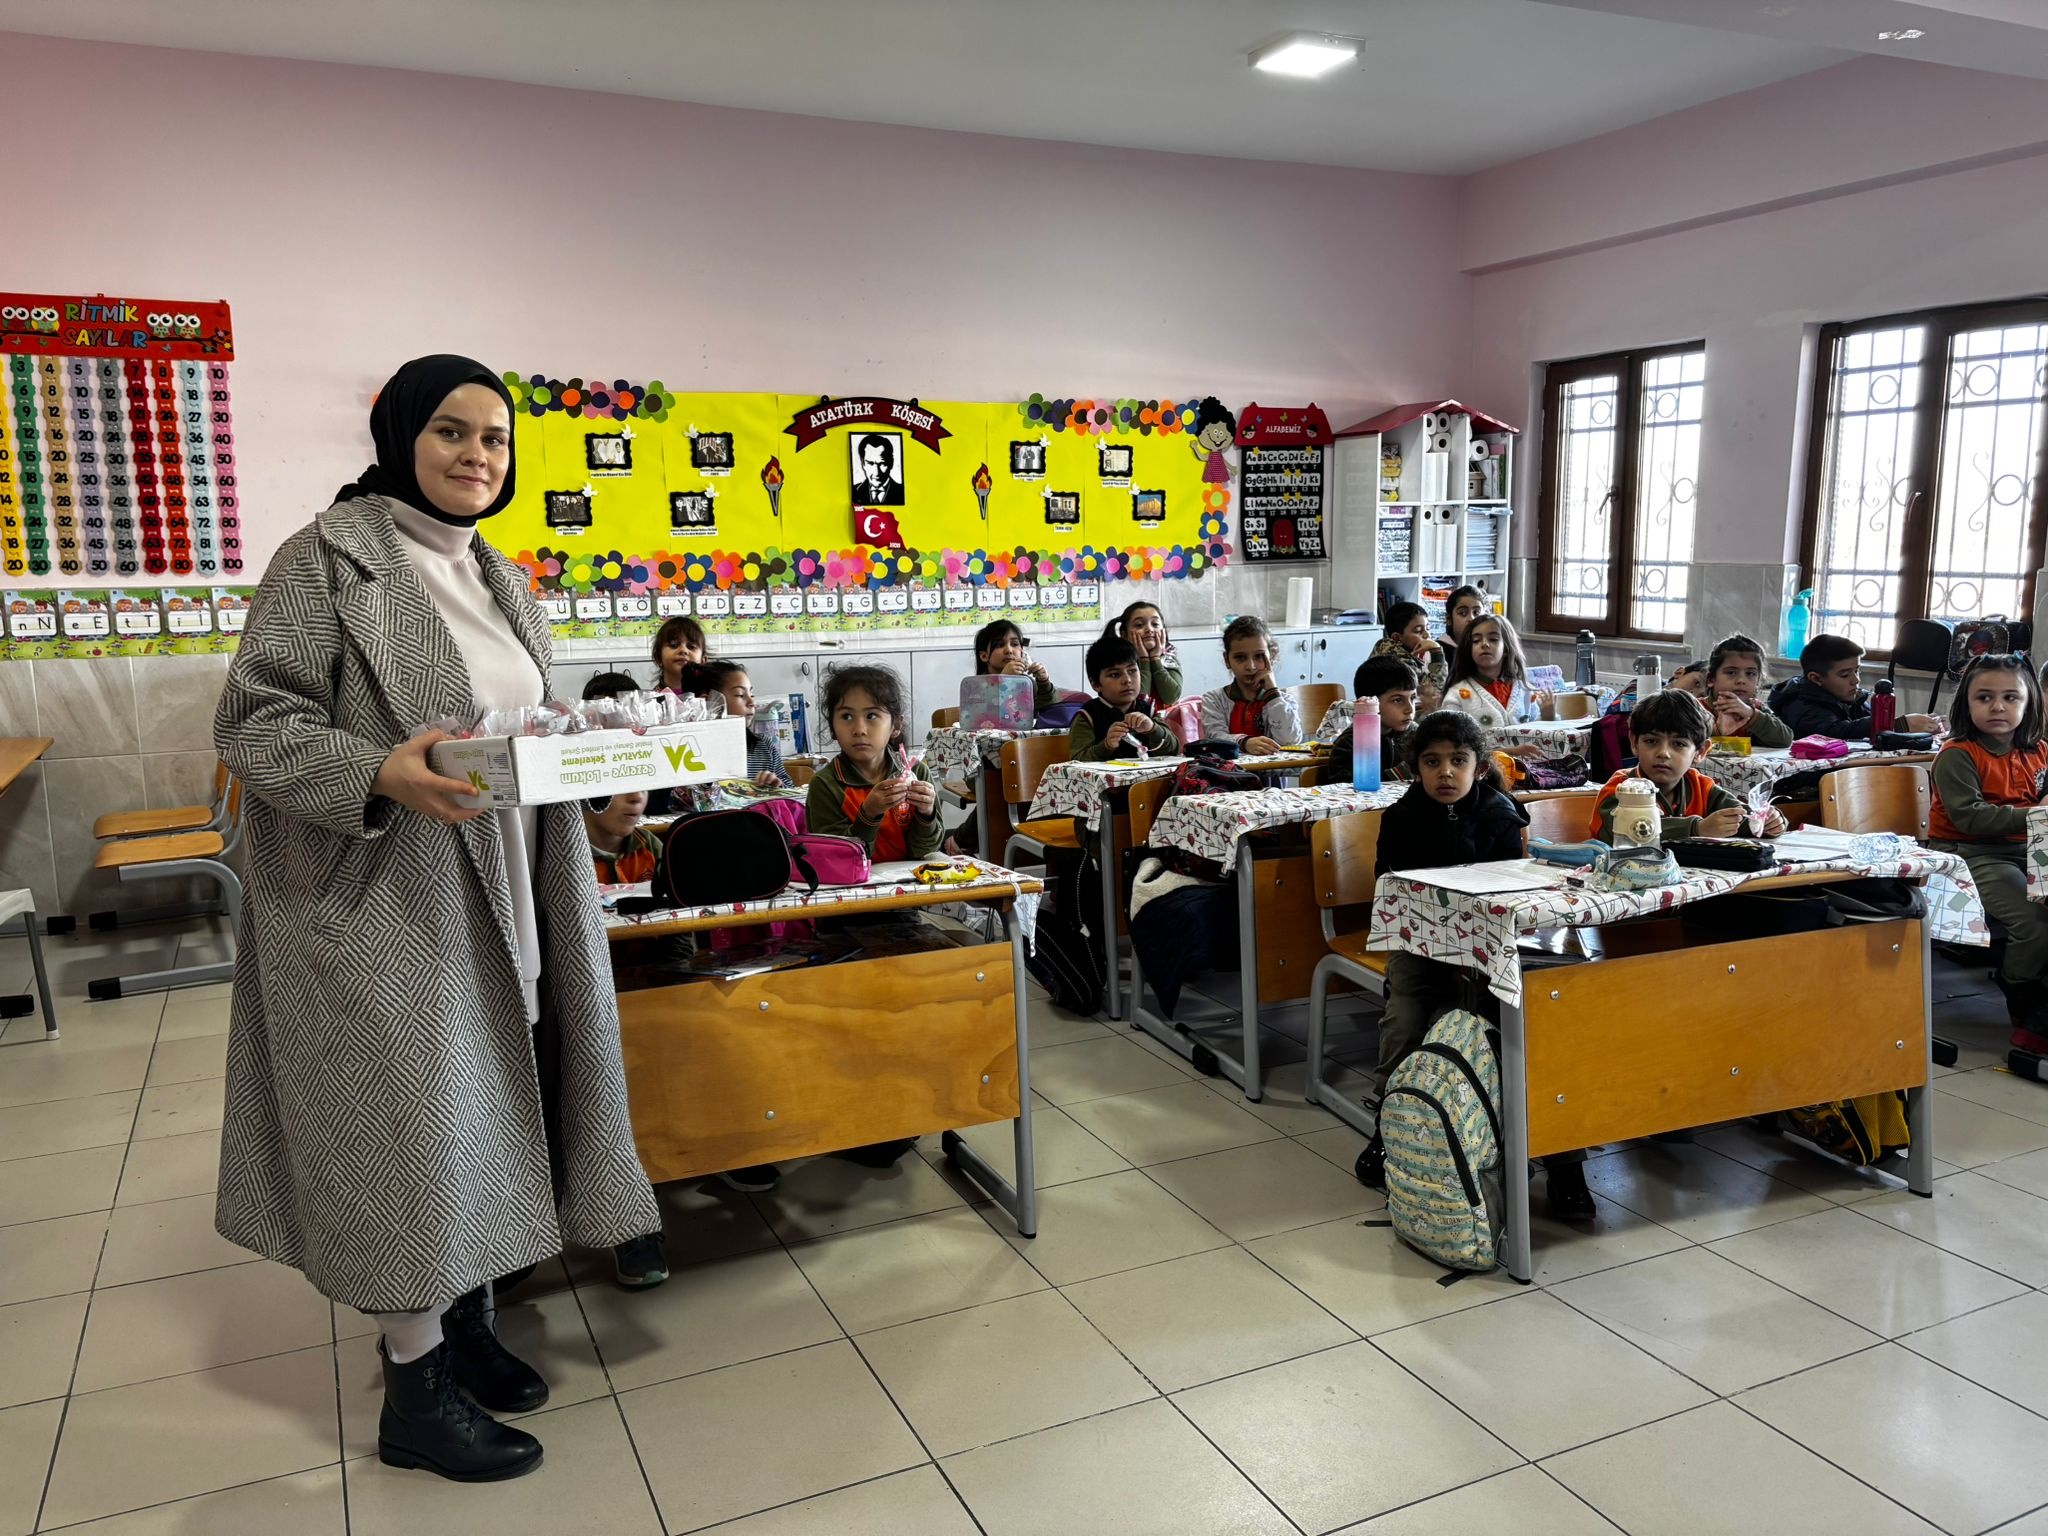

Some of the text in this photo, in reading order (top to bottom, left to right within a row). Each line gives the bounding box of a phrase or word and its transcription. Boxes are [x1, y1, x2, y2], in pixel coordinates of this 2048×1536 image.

[65, 299, 140, 323] RİTMİK
[62, 327, 148, 349] SAYILAR
[17, 361, 25, 372] 3
[45, 364, 54, 374] 4
[75, 364, 82, 375] 5
[104, 366, 111, 376] 6
[160, 367, 167, 377] 8
[187, 368, 195, 378] 9
[212, 369, 224, 379] 10
[20, 385, 28, 395] 6
[48, 385, 56, 396] 8
[75, 387, 88, 397] 10
[104, 388, 115, 399] 12
[160, 389, 170, 399] 16
[187, 390, 198, 400] 18
[213, 391, 227, 401] 20
[23, 406, 30, 417] 9
[48, 406, 60, 417] 12
[78, 409, 89, 419] 15
[106, 411, 118, 422] 18
[161, 411, 174, 421] 24
[810, 401, 935, 431] ATATÜRK KÖŞESİ
[189, 412, 201, 422] 27
[214, 412, 228, 423] 30
[23, 428, 34, 439] 12
[1265, 423, 1302, 434] ALFABEMİZ
[51, 429, 63, 440] 16
[79, 430, 94, 441] 20
[107, 432, 121, 442] 24
[163, 432, 176, 442] 32
[189, 432, 203, 443] 36
[215, 434, 230, 444] 40
[23, 451, 36, 461] 15
[51, 451, 66, 461] 20
[80, 452, 94, 463] 25
[109, 453, 124, 464] 30
[163, 454, 179, 464] 40
[191, 455, 205, 465] 45
[217, 454, 231, 464] 50
[25, 472, 37, 483] 18
[54, 473, 68, 483] 24
[82, 475, 97, 485] 30
[112, 475, 126, 486] 36
[166, 476, 181, 485] 48
[193, 476, 208, 486] 54
[219, 476, 234, 486] 60
[27, 494, 37, 504] 21
[57, 496, 71, 506] 28
[85, 496, 99, 506] 35
[113, 497, 128, 507] 42
[170, 496, 183, 506] 56
[195, 497, 209, 507] 63
[220, 497, 234, 507] 70
[4, 517, 16, 527] 16
[29, 517, 42, 527] 24
[58, 516, 72, 526] 32
[86, 518, 103, 528] 40
[115, 519, 131, 529] 48
[171, 518, 185, 527] 64
[197, 518, 210, 528] 72
[222, 517, 236, 528] 80
[7, 538, 18, 548] 18
[31, 539, 44, 549] 27
[60, 538, 75, 548] 36
[89, 539, 104, 549] 45
[118, 540, 133, 550] 54
[173, 538, 185, 548] 72
[200, 538, 210, 548] 81
[224, 538, 238, 548] 90
[7, 560, 23, 570] 20
[32, 560, 48, 571] 30
[61, 560, 78, 570] 40
[92, 560, 107, 570] 50
[120, 561, 136, 571] 60
[175, 560, 189, 570] 80
[200, 560, 215, 570] 90
[223, 558, 242, 569] 100
[982, 591, 1002, 602] h H
[1026, 591, 1034, 600] V
[1077, 588, 1095, 598] f F
[702, 598, 726, 609] d D
[754, 598, 762, 609] Z
[776, 597, 799, 611] ç Ç
[812, 597, 833, 608] b B
[895, 594, 904, 605] C
[930, 593, 937, 606] Ş
[950, 592, 969, 606] p P
[556, 598, 566, 614] Ü
[599, 600, 606, 612] S
[622, 603, 628, 612] ö
[663, 599, 686, 615] y Y
[847, 597, 870, 612] g G
[38, 616, 51, 630] N
[93, 616, 103, 629] E
[124, 614, 153, 628] t T
[177, 617, 181, 627] i
[226, 613, 231, 625] l
[562, 749, 653, 765] AVŞARLAR Şekerleme
[612, 764, 656, 778] Cezerye
[560, 769, 601, 784] Lokum
